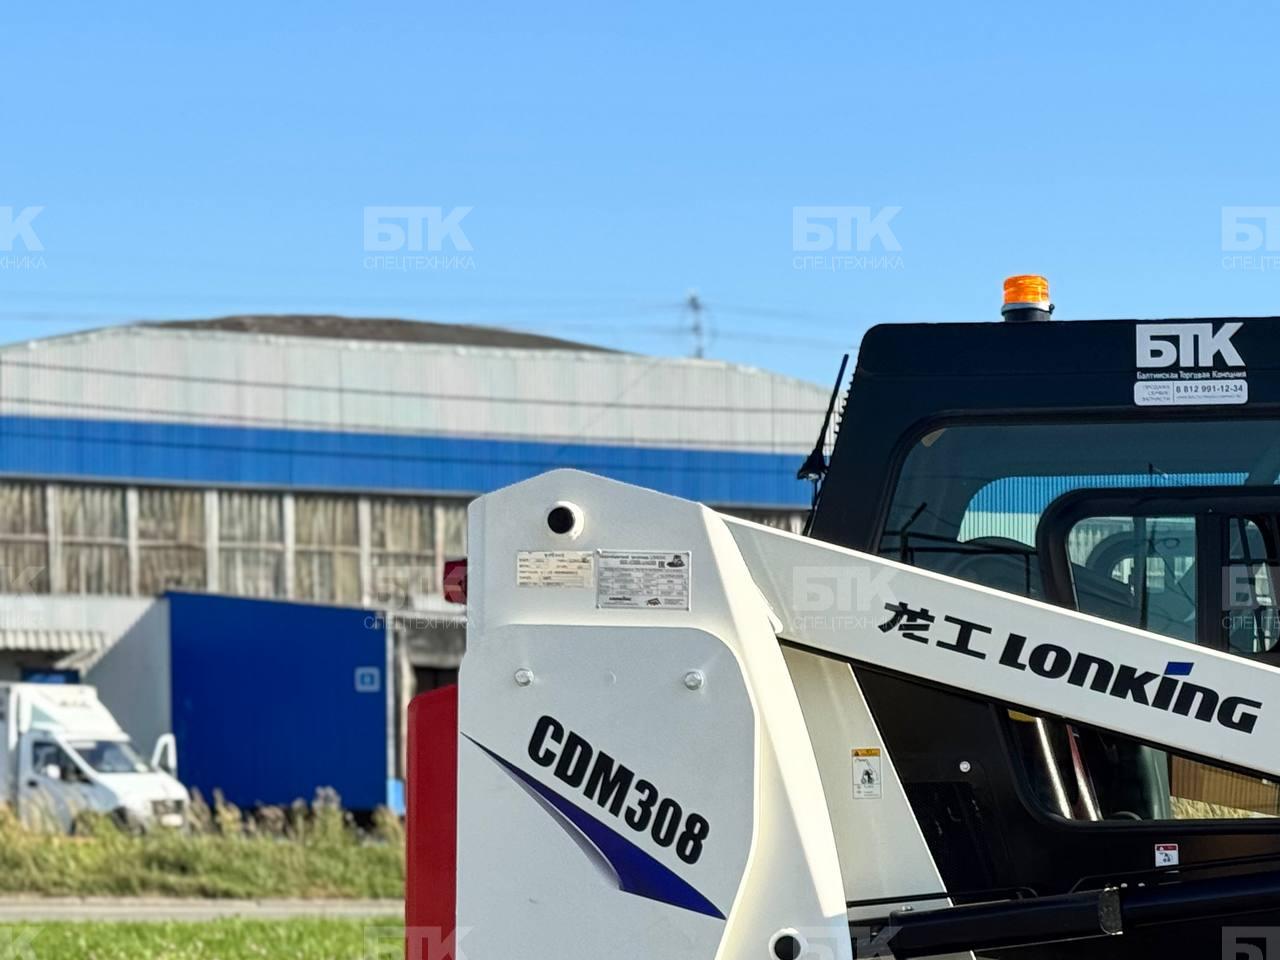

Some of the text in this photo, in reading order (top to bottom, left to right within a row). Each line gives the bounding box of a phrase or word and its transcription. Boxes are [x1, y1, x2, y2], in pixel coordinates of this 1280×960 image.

[1136, 322, 1246, 368] БТК
[1183, 385, 1199, 393] 812
[1201, 384, 1243, 393] 991-12-34
[877, 601, 993, 660] 龙工
[527, 715, 710, 865] CDM308
